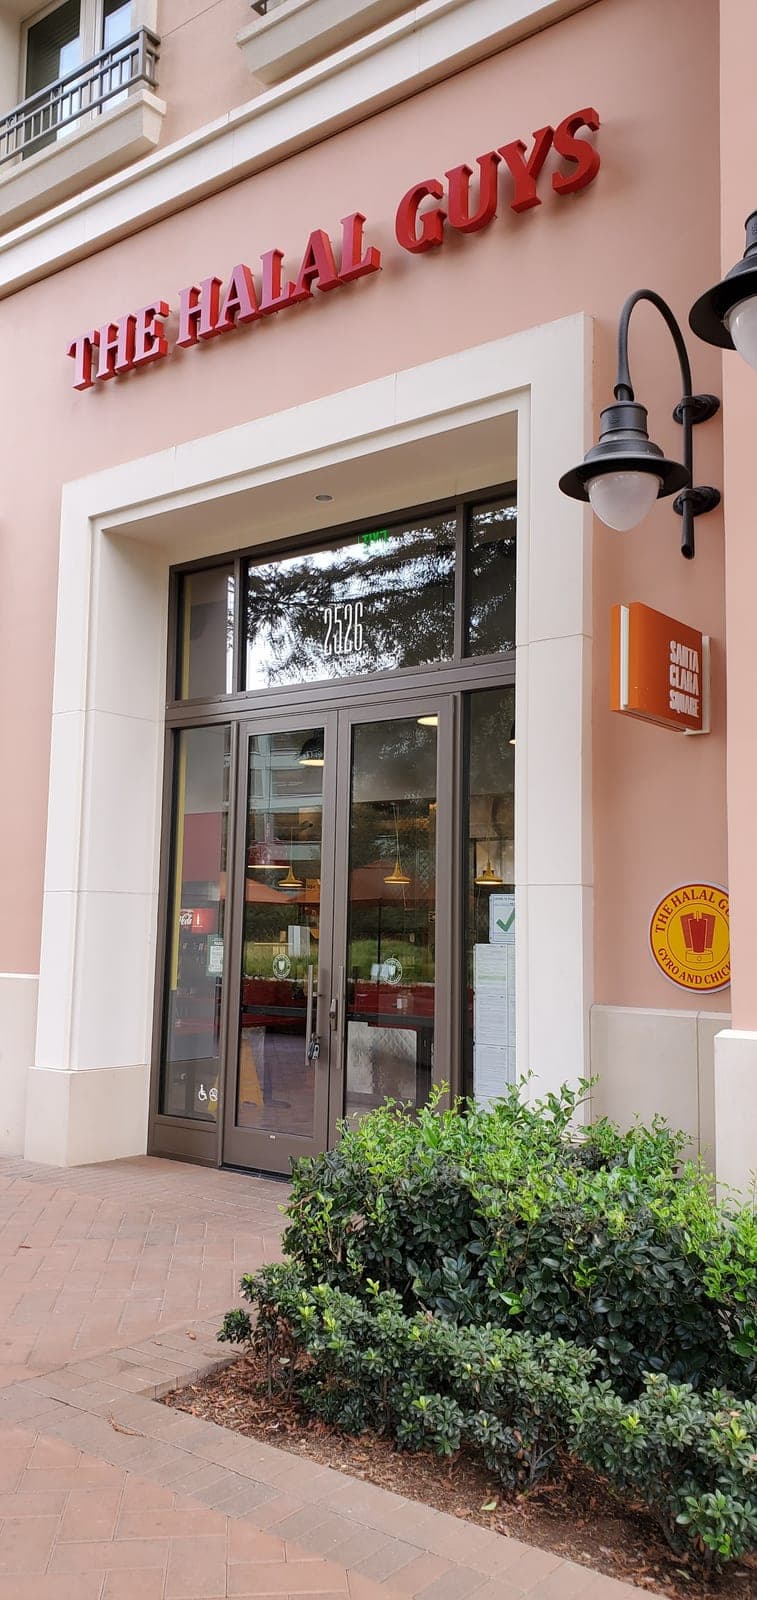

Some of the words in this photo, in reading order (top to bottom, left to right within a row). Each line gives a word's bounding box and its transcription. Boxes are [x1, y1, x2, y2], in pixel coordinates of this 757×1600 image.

[67, 301, 169, 391] THE
[177, 212, 381, 348] HALAL
[395, 107, 601, 254] GUYS
[323, 602, 364, 655] 2526
[669, 640, 699, 673] SANTA
[669, 663, 699, 696] CLARA
[655, 904, 673, 933] THE
[671, 889, 715, 908] HALAL
[658, 947, 680, 975] GYRO
[679, 972, 702, 985] AND
